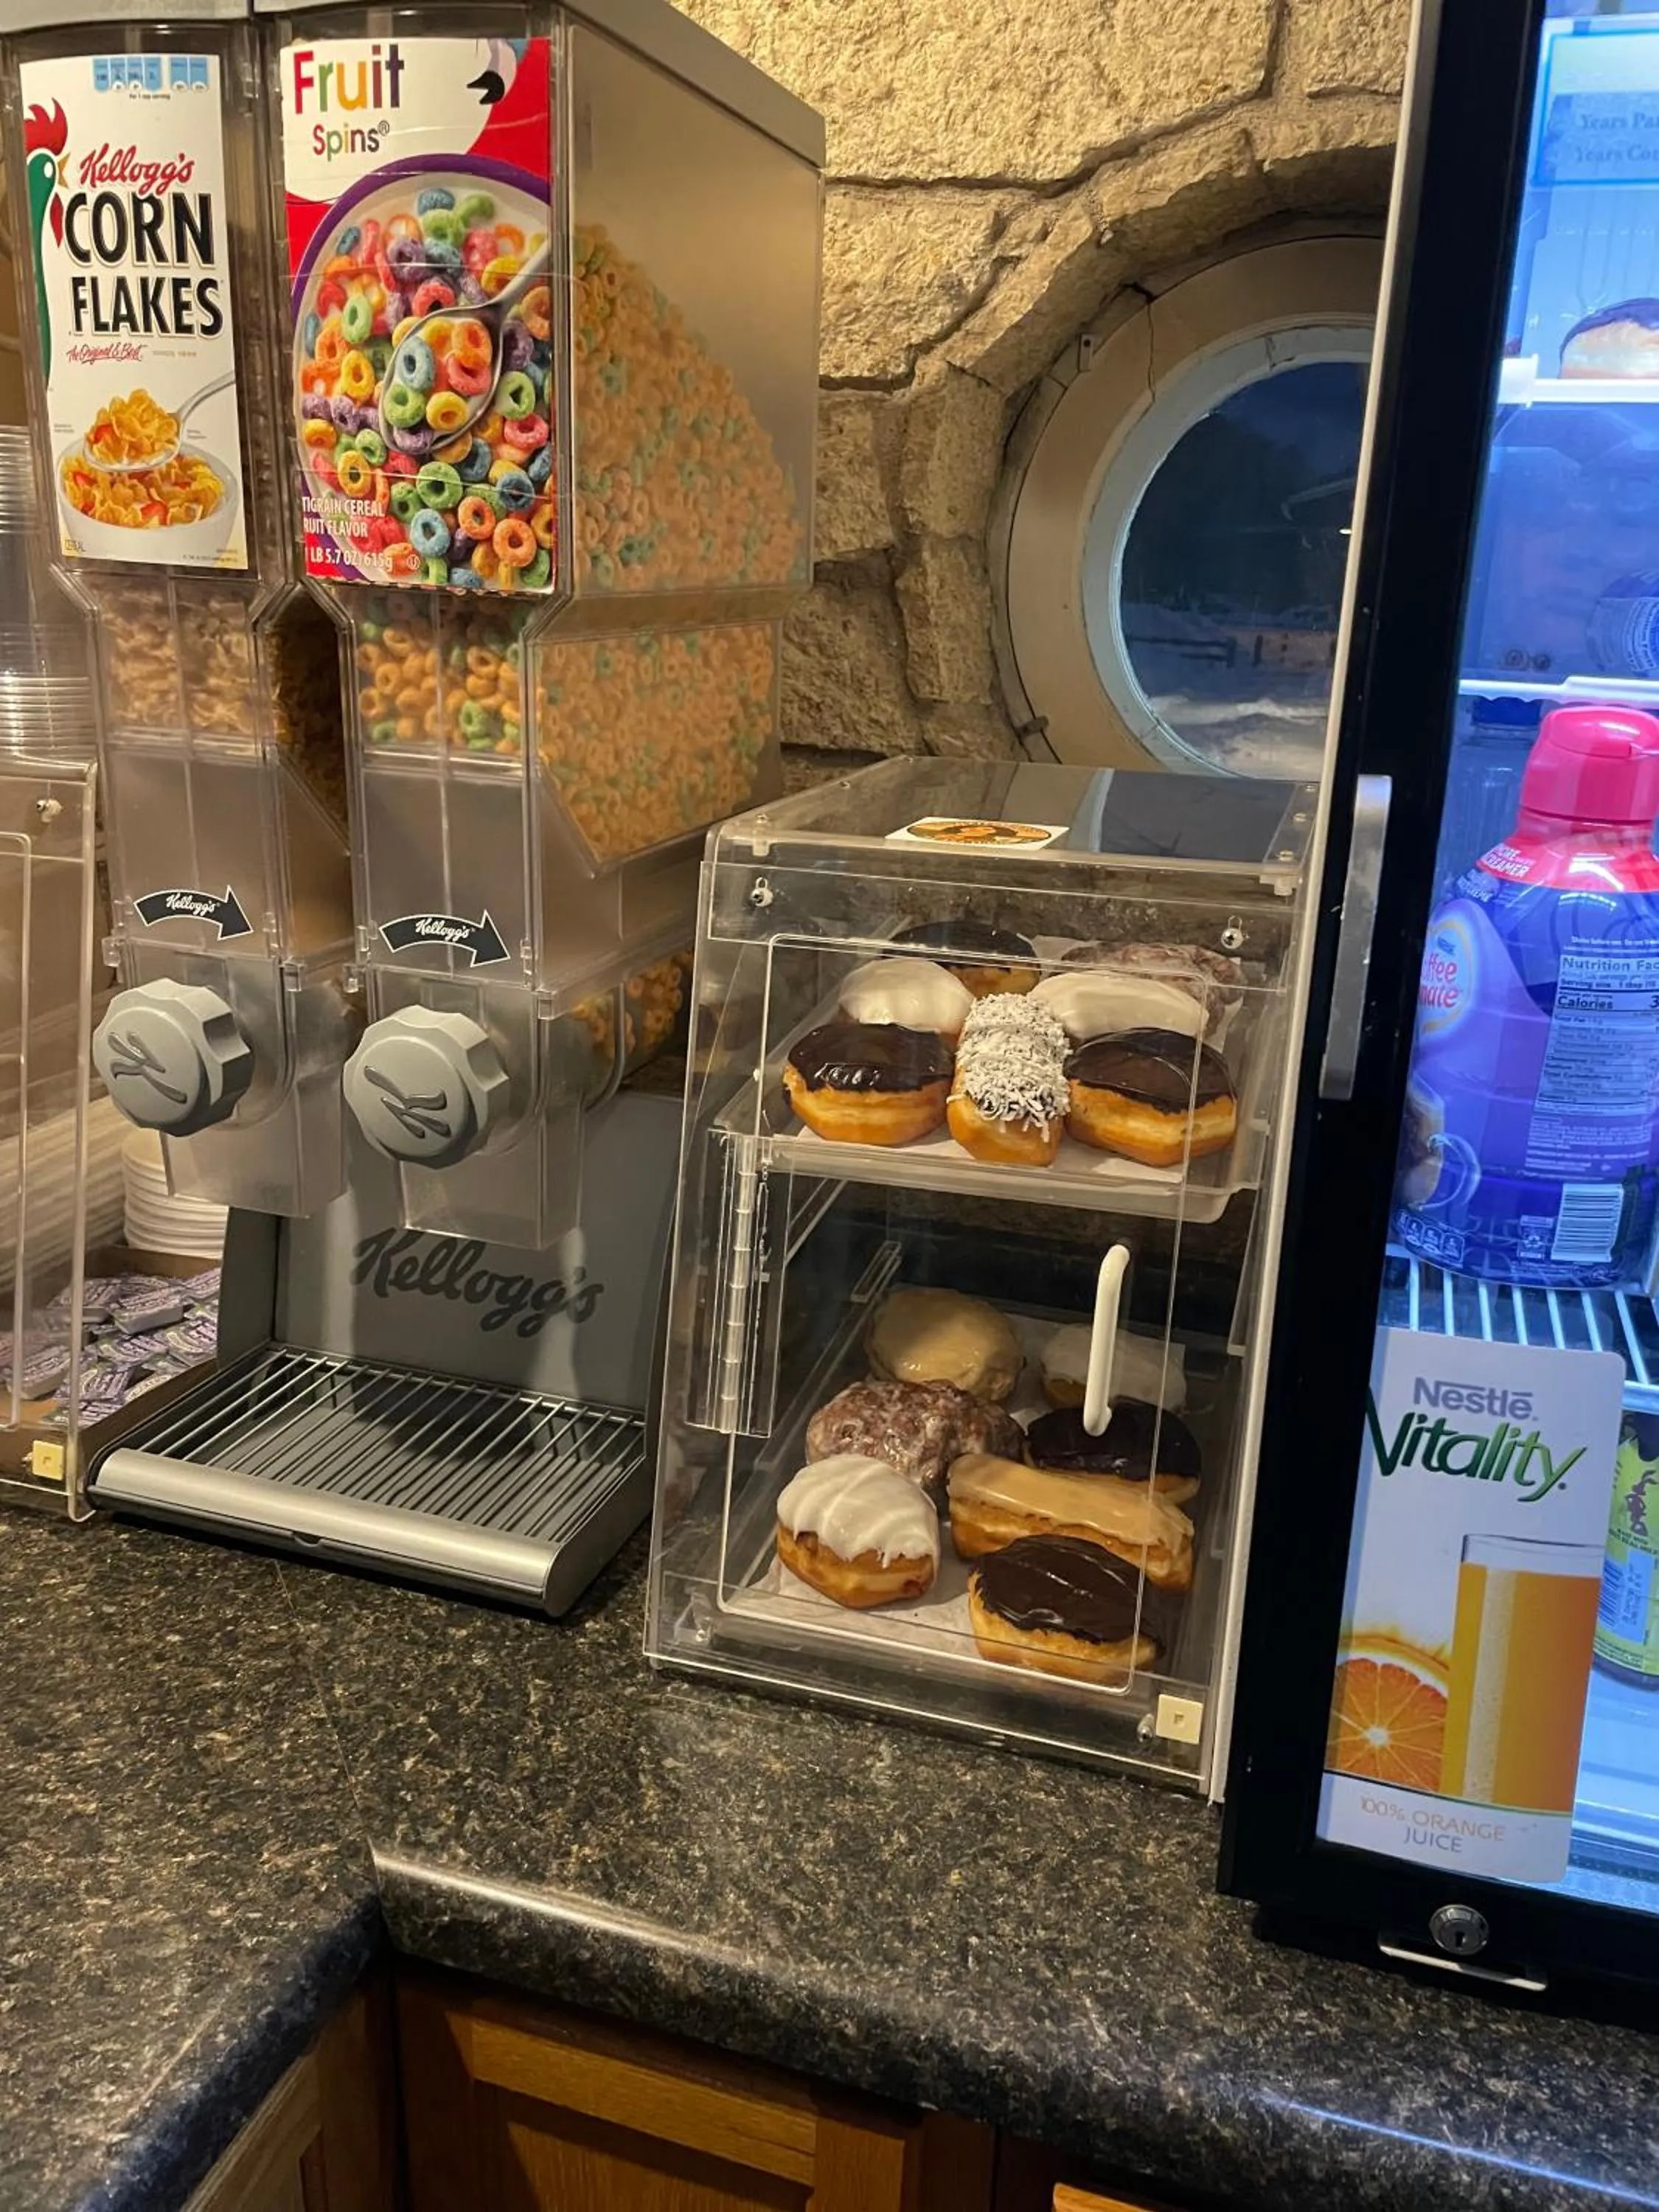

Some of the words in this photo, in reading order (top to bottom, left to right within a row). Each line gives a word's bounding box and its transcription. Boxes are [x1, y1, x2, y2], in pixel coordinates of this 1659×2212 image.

[293, 44, 405, 115] Fruit
[79, 142, 195, 196] Kellogg's
[64, 191, 215, 264] CORN
[70, 276, 223, 336] FLAKES
[344, 499, 386, 517] CEREAL
[327, 518, 368, 538] FLAVOR
[310, 546, 324, 563] LB
[325, 548, 341, 564] 5.7
[166, 892, 215, 917] Kellogg's
[415, 917, 470, 942] Kellogg's
[1562, 957, 1630, 972] Nutrition
[1557, 995, 1613, 1009] Calories
[349, 1226, 605, 1338] Kellogg's
[1366, 1385, 1587, 1503] Vitality
[1360, 1795, 1405, 1822] 100%
[1411, 1809, 1507, 1842] ORANGE
[1403, 1826, 1464, 1853] JUICE
